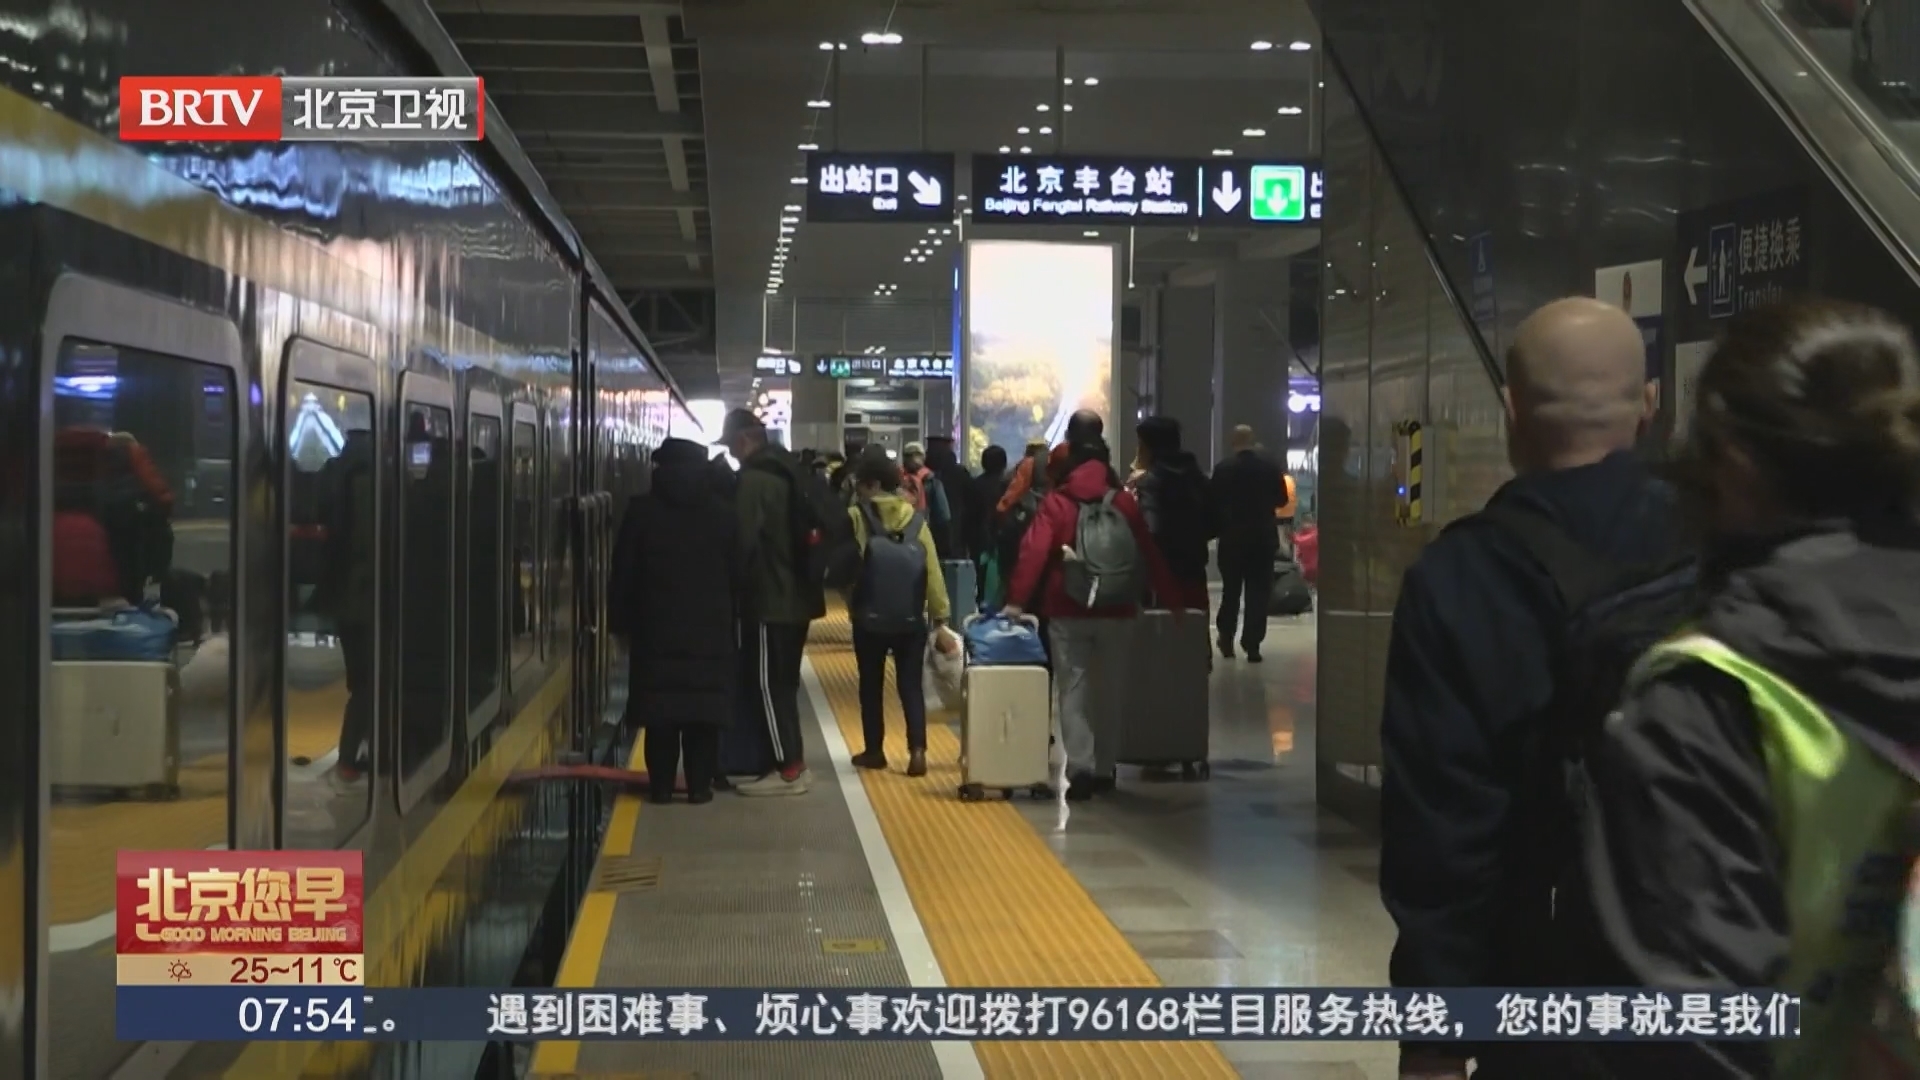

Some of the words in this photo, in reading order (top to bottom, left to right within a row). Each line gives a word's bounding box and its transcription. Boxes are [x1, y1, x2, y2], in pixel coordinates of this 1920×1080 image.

[820, 164, 898, 193] 出站口
[1000, 165, 1174, 195] 北京丰台站
[1738, 216, 1801, 275] 便捷换乘
